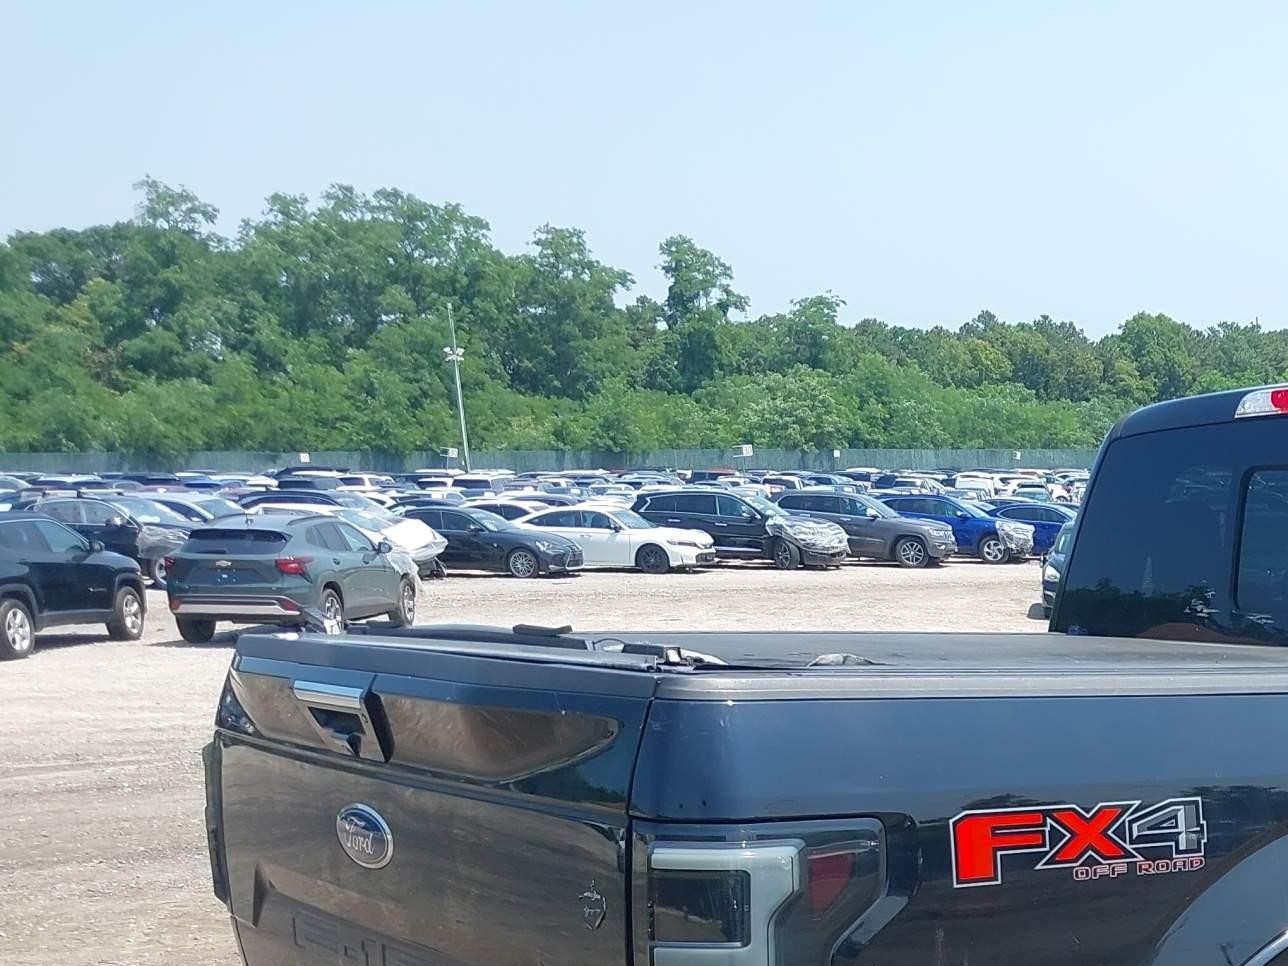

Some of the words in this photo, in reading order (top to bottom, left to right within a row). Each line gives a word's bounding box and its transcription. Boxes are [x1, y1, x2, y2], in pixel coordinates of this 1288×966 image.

[949, 797, 1208, 888] FX4
[1073, 863, 1127, 881] OFF
[1136, 857, 1206, 875] ROAD
